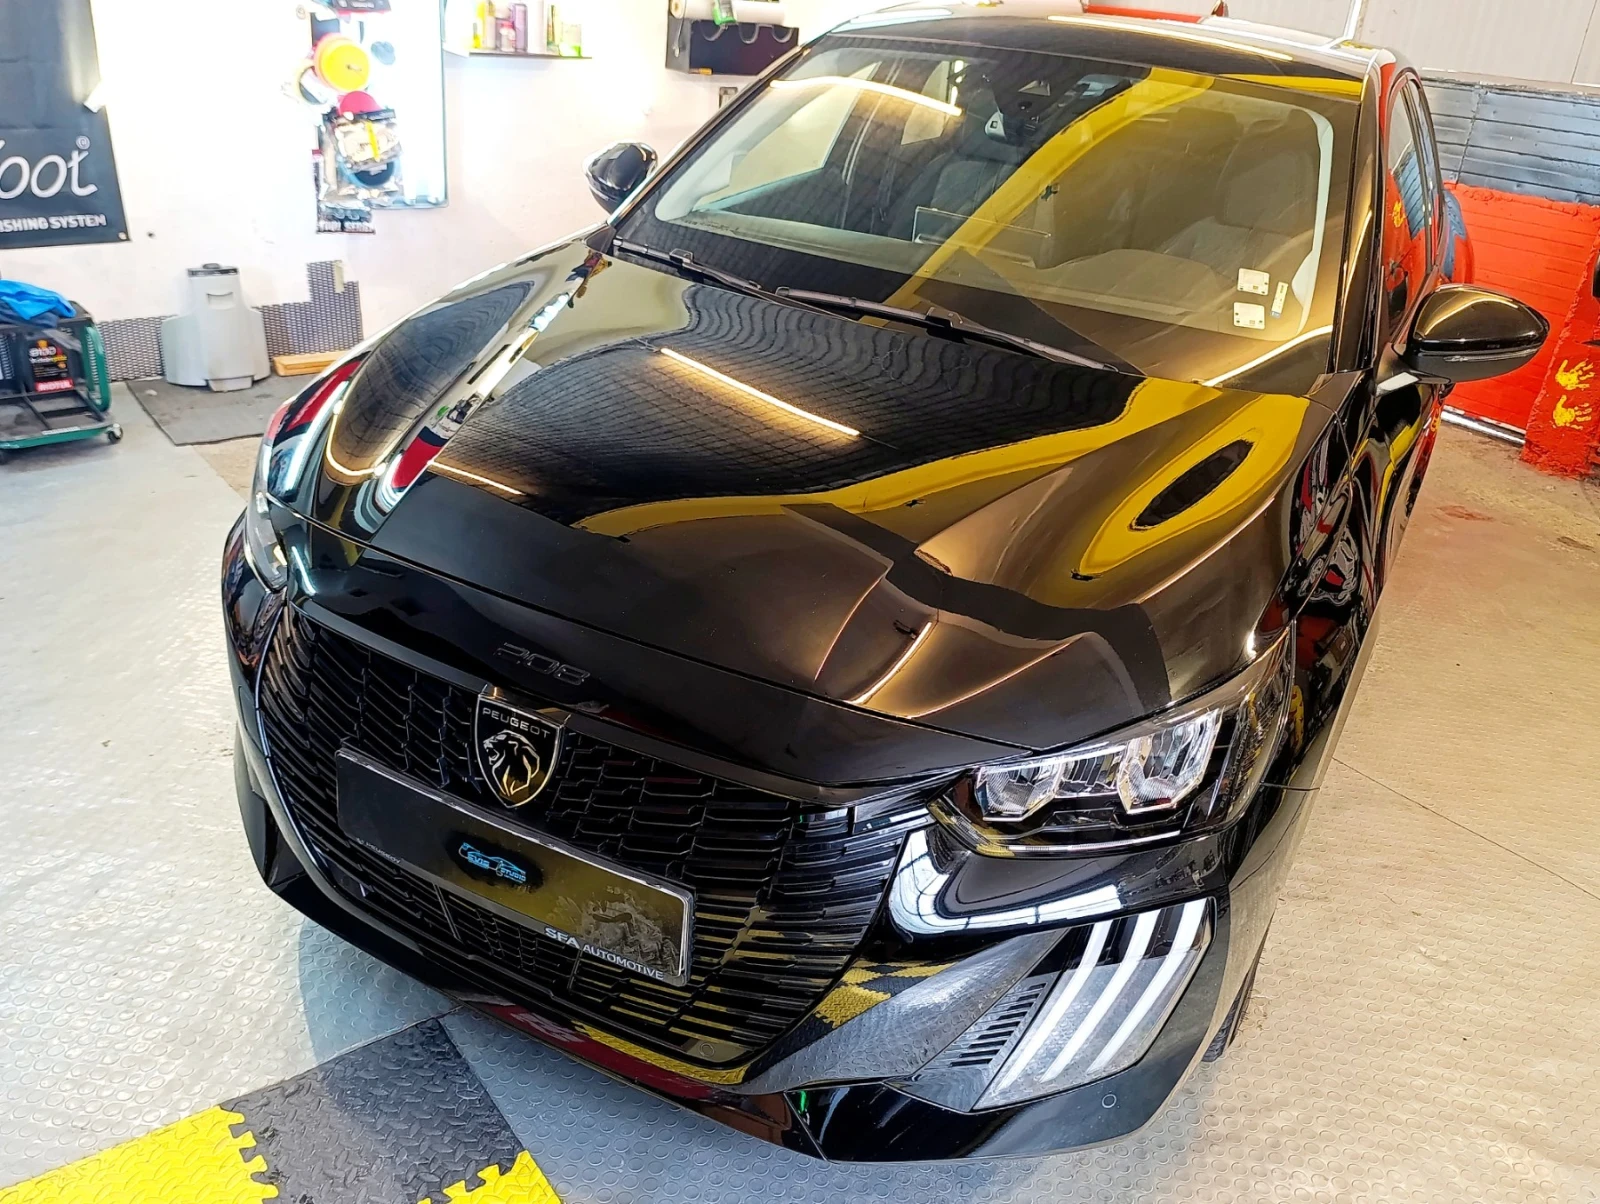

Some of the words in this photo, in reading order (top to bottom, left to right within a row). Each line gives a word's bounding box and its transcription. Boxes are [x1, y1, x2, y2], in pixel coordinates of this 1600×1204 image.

[49, 214, 107, 230] SYSTEM
[494, 642, 591, 685] 208
[482, 707, 551, 738] PEUGEOT
[582, 944, 665, 980] AUTOMOTIVE
